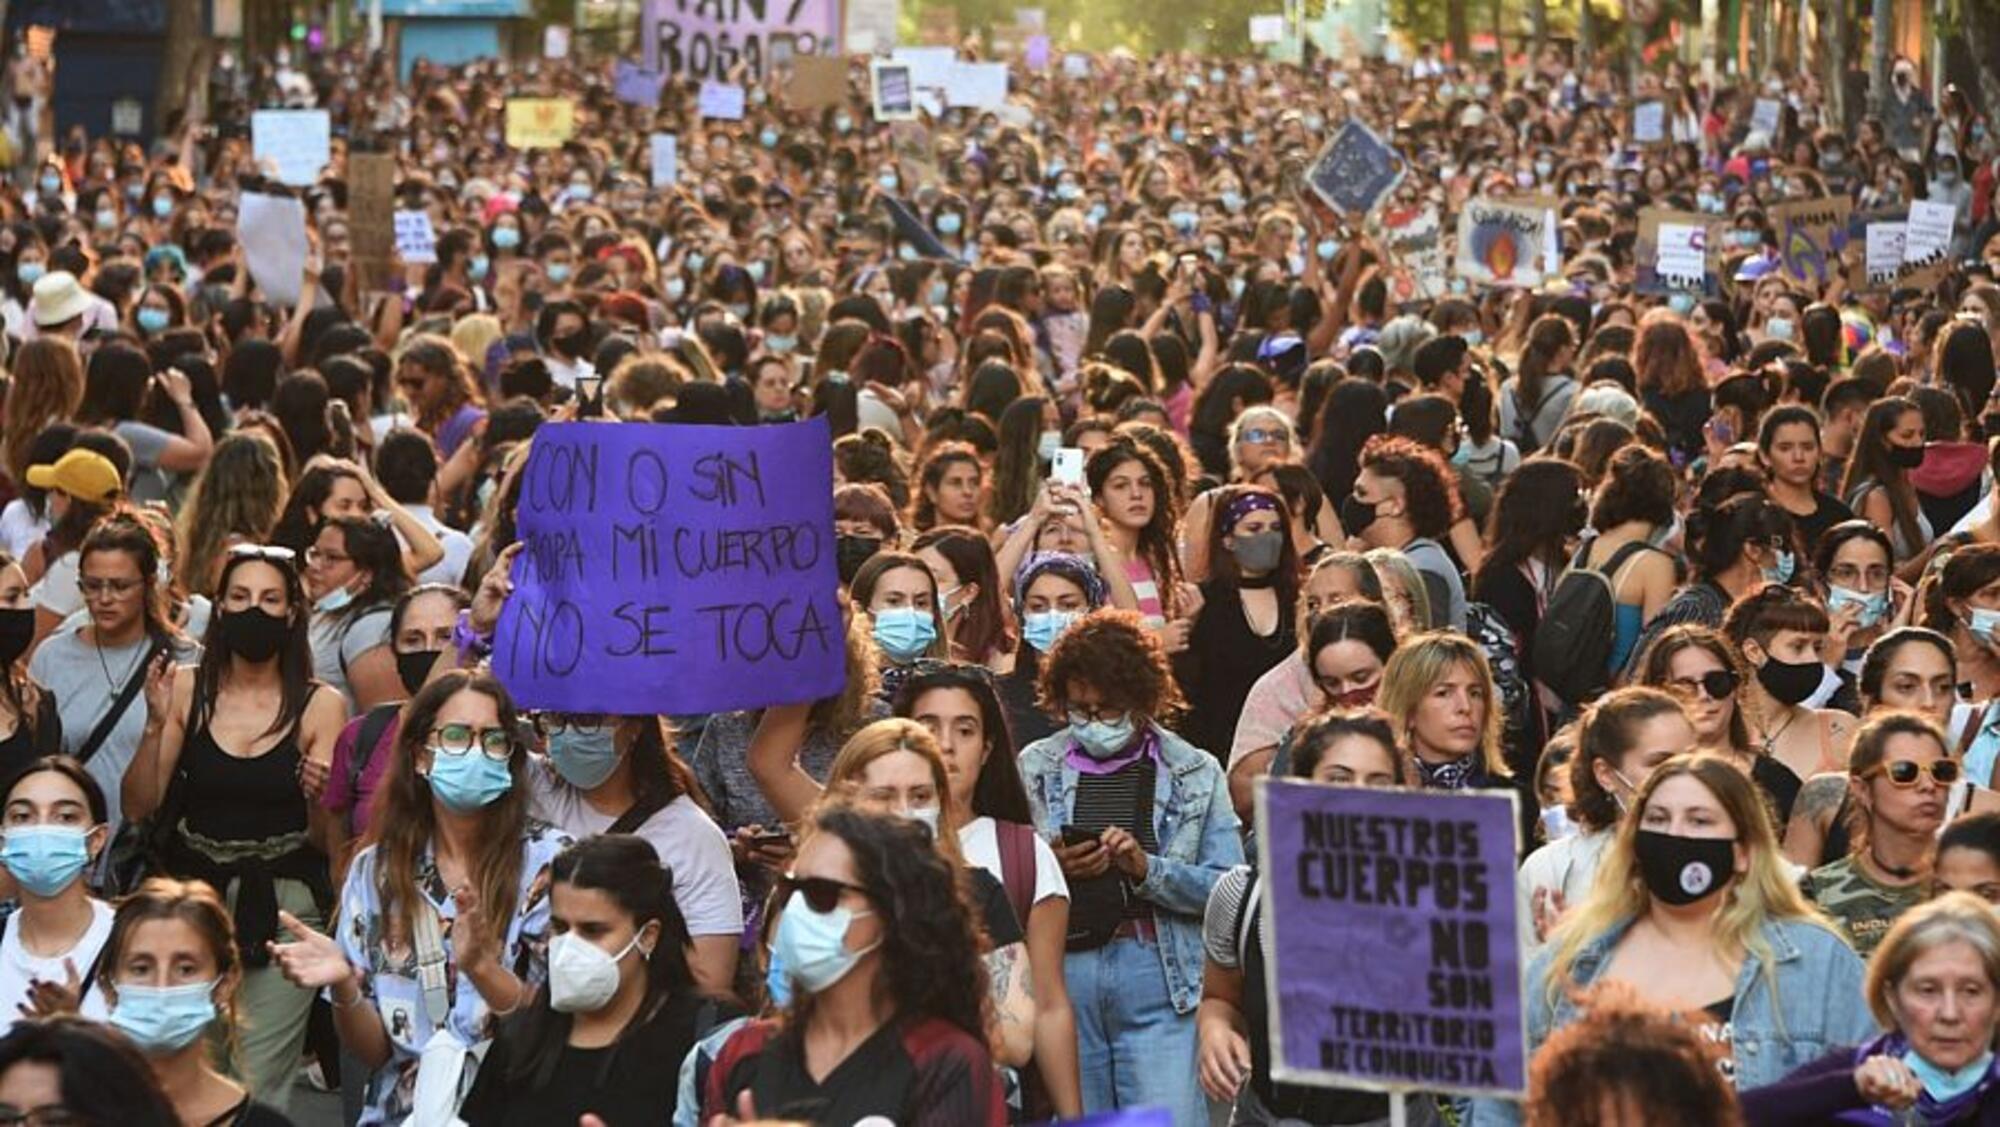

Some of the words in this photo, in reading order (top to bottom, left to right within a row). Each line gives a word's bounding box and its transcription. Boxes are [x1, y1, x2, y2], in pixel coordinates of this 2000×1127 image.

[529, 441, 597, 513] CON
[628, 449, 668, 515] O
[523, 525, 585, 586] ROPA
[674, 520, 819, 580] CUERPO
[509, 591, 584, 680] NO
[605, 602, 677, 657] SE
[696, 596, 831, 662] TOCA
[1302, 810, 1479, 859] NUESTROS
[1297, 852, 1488, 912] CUERPOS
[1430, 918, 1490, 970] NO
[1428, 971, 1493, 1010] SON
[1320, 1038, 1349, 1072] DE
